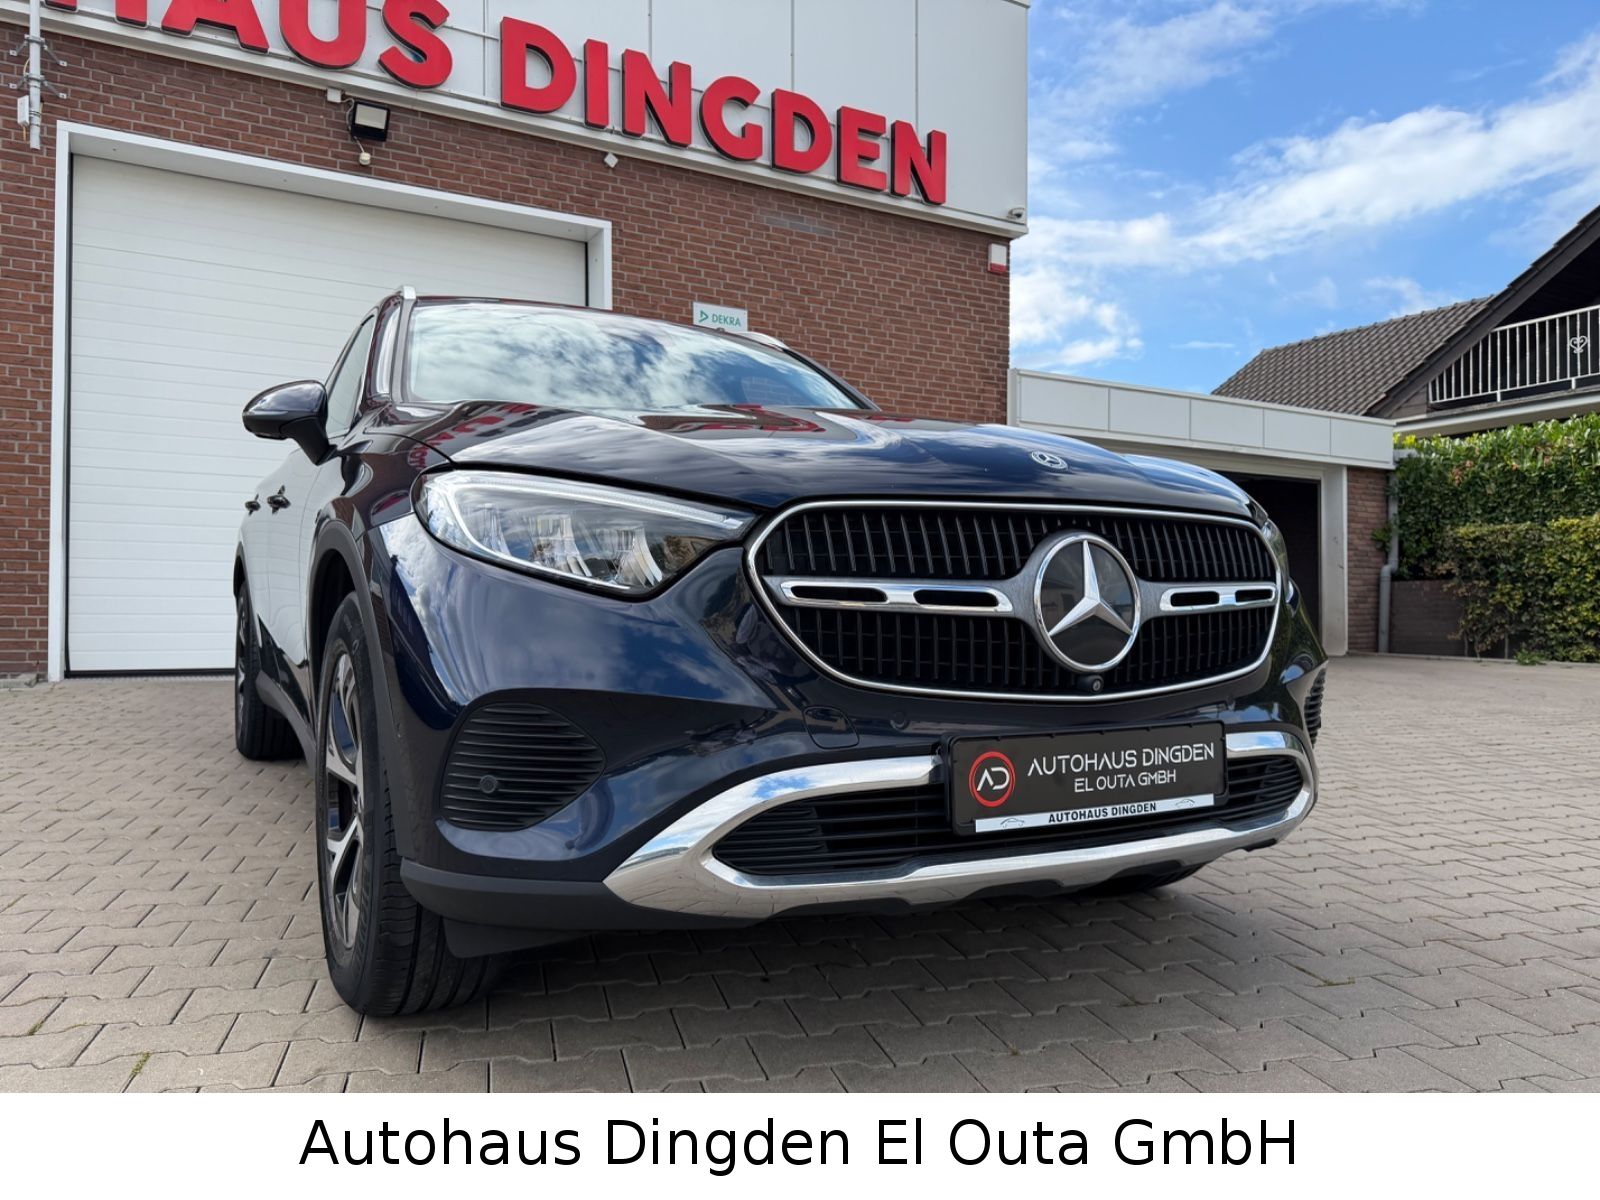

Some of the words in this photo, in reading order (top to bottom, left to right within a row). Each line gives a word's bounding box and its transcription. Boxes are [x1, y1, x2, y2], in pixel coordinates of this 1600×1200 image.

[44, 0, 453, 87] AUS
[501, 17, 947, 205] DINGDEN
[712, 313, 741, 327] DEKRA
[1027, 750, 1137, 776] AUTOHAUS
[1142, 743, 1215, 766] DINGDEN
[1074, 778, 1094, 793] EL
[1096, 774, 1136, 791] OUTA
[1137, 769, 1177, 787] GMBH
[1048, 807, 1109, 824] AUTOHAUS
[1111, 802, 1157, 816] DINGDEN
